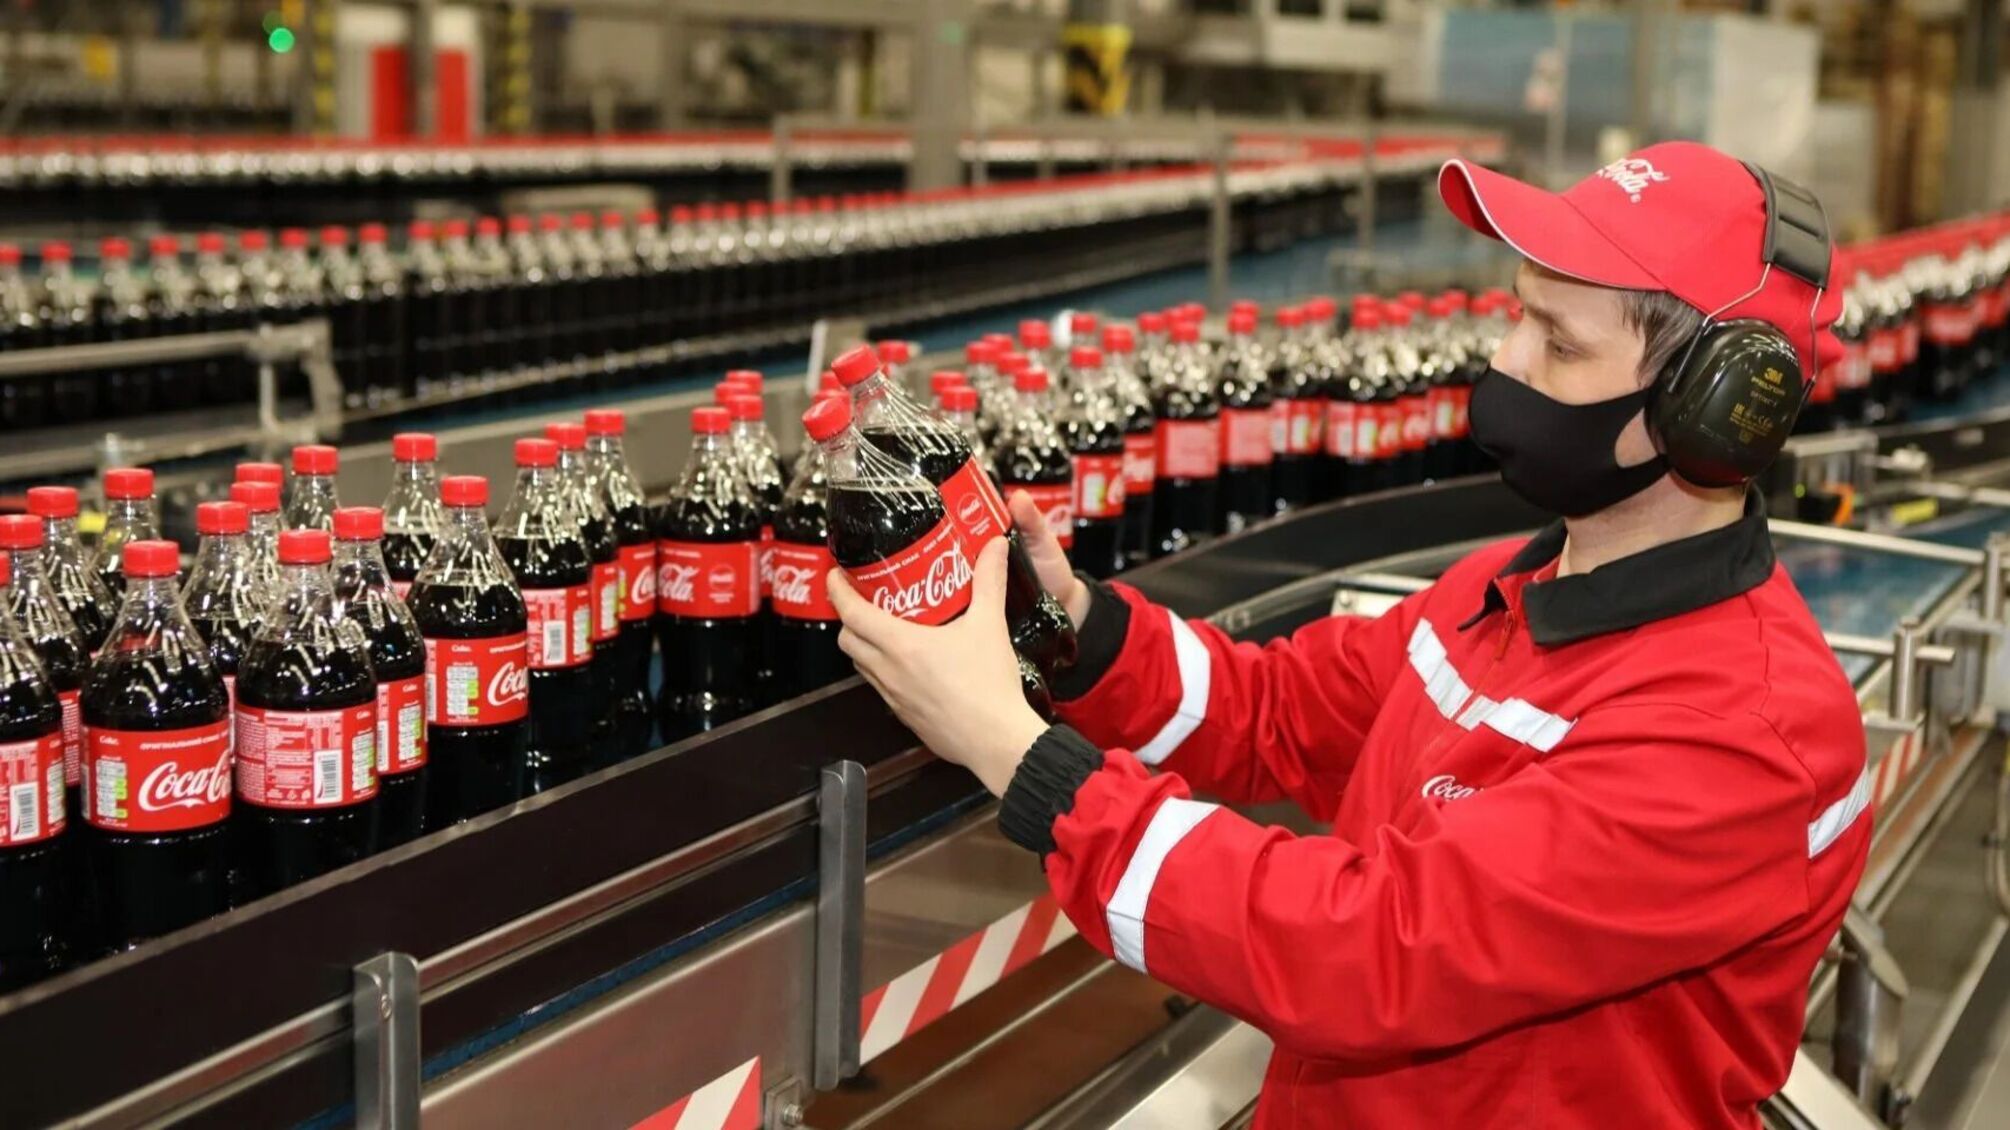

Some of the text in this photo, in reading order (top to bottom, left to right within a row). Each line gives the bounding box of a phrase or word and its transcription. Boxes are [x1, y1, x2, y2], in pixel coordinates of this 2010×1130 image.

[1764, 367, 1783, 385] 3M
[873, 540, 973, 617] Coca-Cola
[138, 747, 232, 812] Coca-Co
[1421, 774, 1485, 802] Coca-
